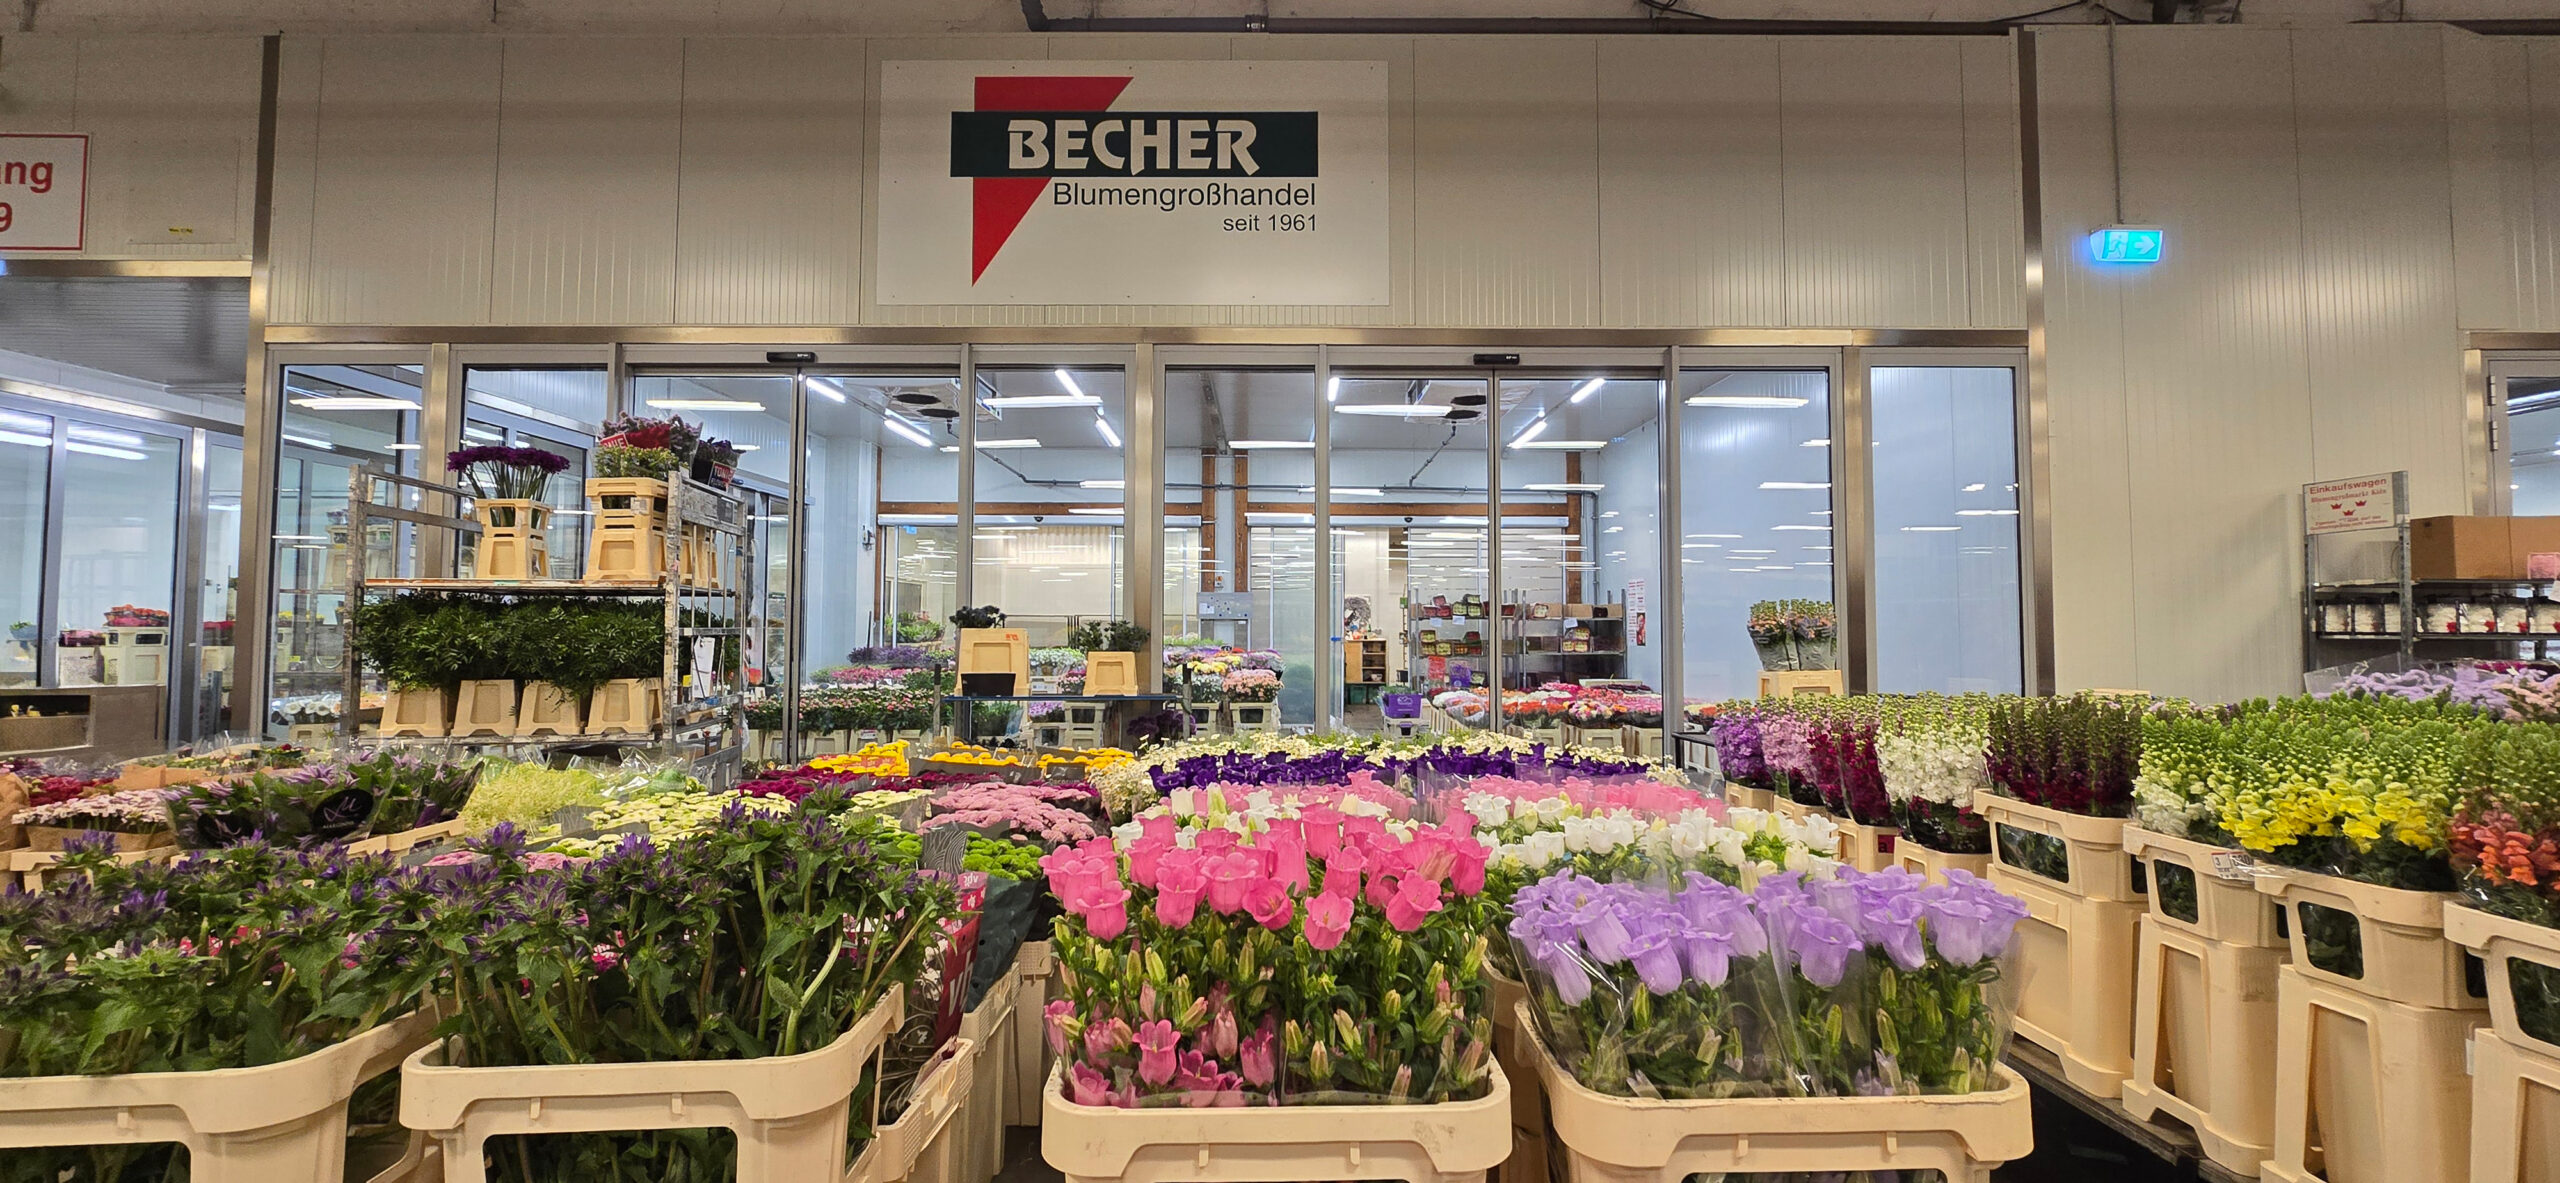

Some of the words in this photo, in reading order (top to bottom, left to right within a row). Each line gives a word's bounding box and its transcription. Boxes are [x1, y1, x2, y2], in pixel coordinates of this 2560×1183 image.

[1007, 119, 1261, 176] BECHER
[0, 161, 53, 194] ng
[1053, 182, 1316, 212] Blumengroßhandel
[1223, 213, 1260, 232] seit
[1268, 213, 1316, 232] 1961
[2309, 478, 2387, 495] Einkaufswagen
